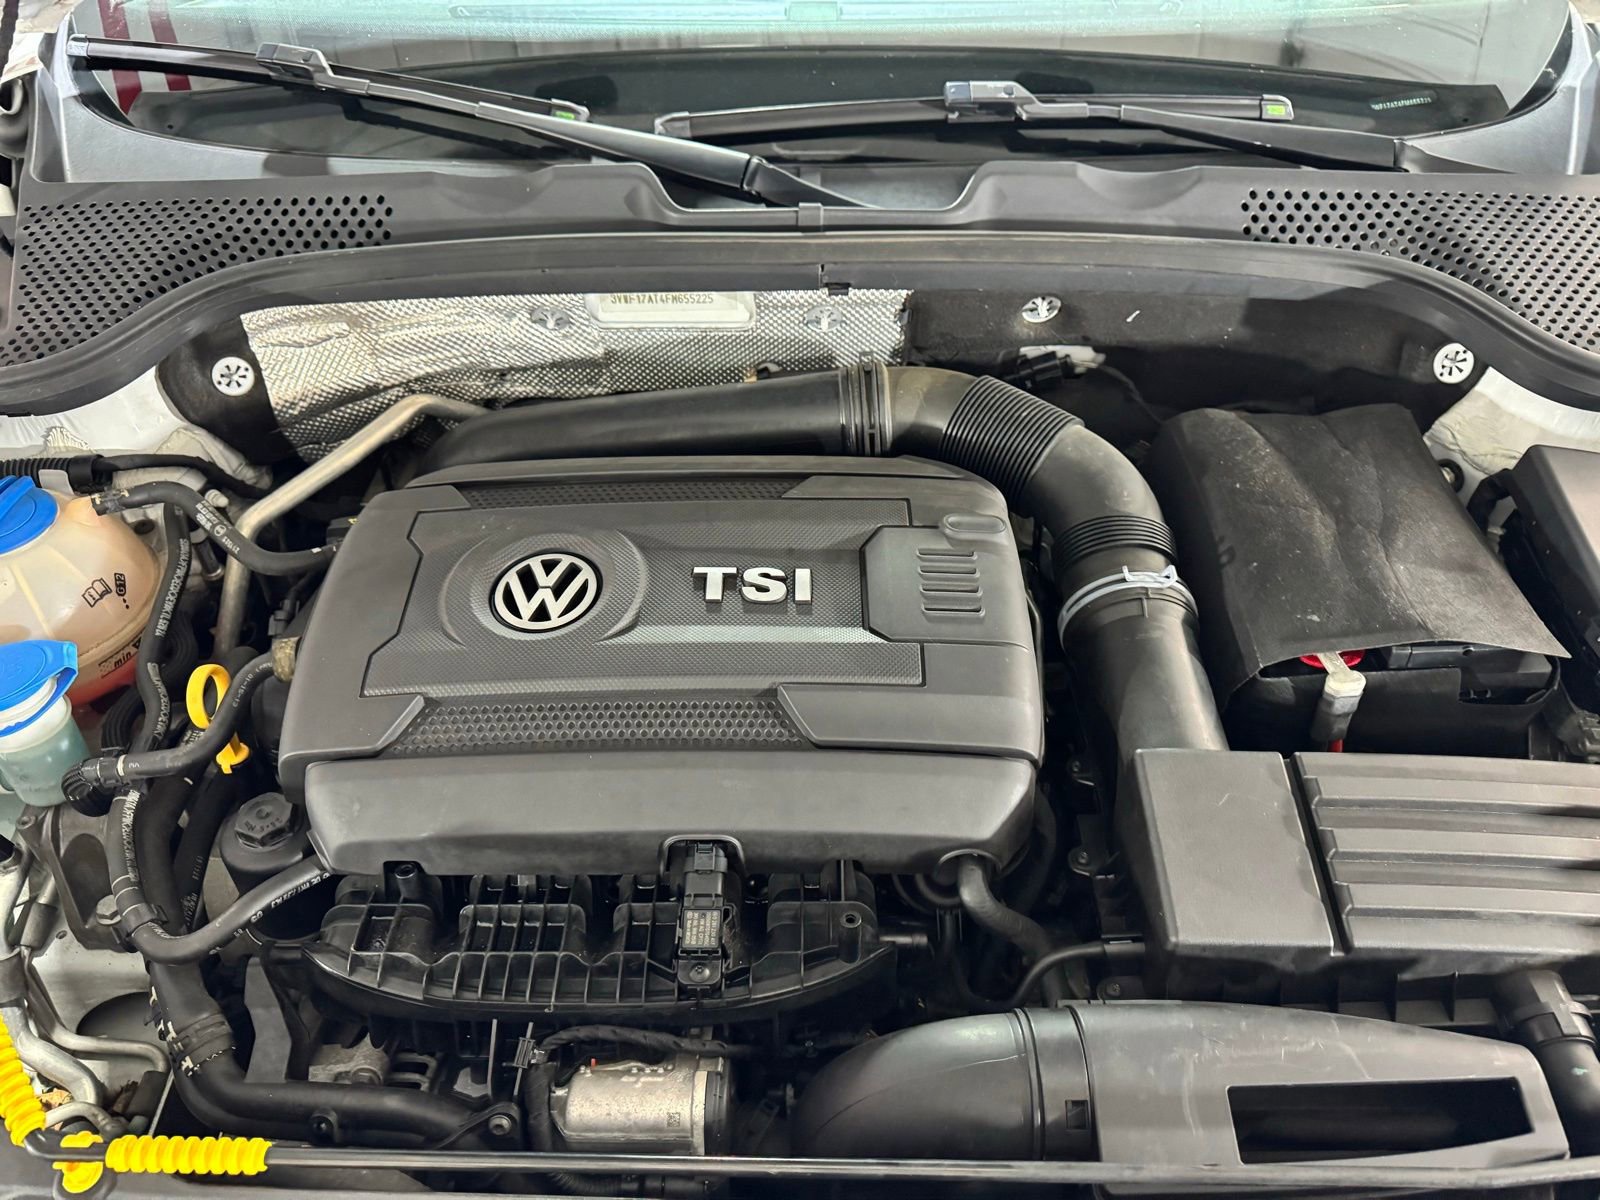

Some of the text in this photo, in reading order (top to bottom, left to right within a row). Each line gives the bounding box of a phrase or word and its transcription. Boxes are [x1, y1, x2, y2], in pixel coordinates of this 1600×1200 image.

[115, 573, 126, 596] G12
[692, 566, 812, 604] TSI
[114, 651, 132, 669] min
